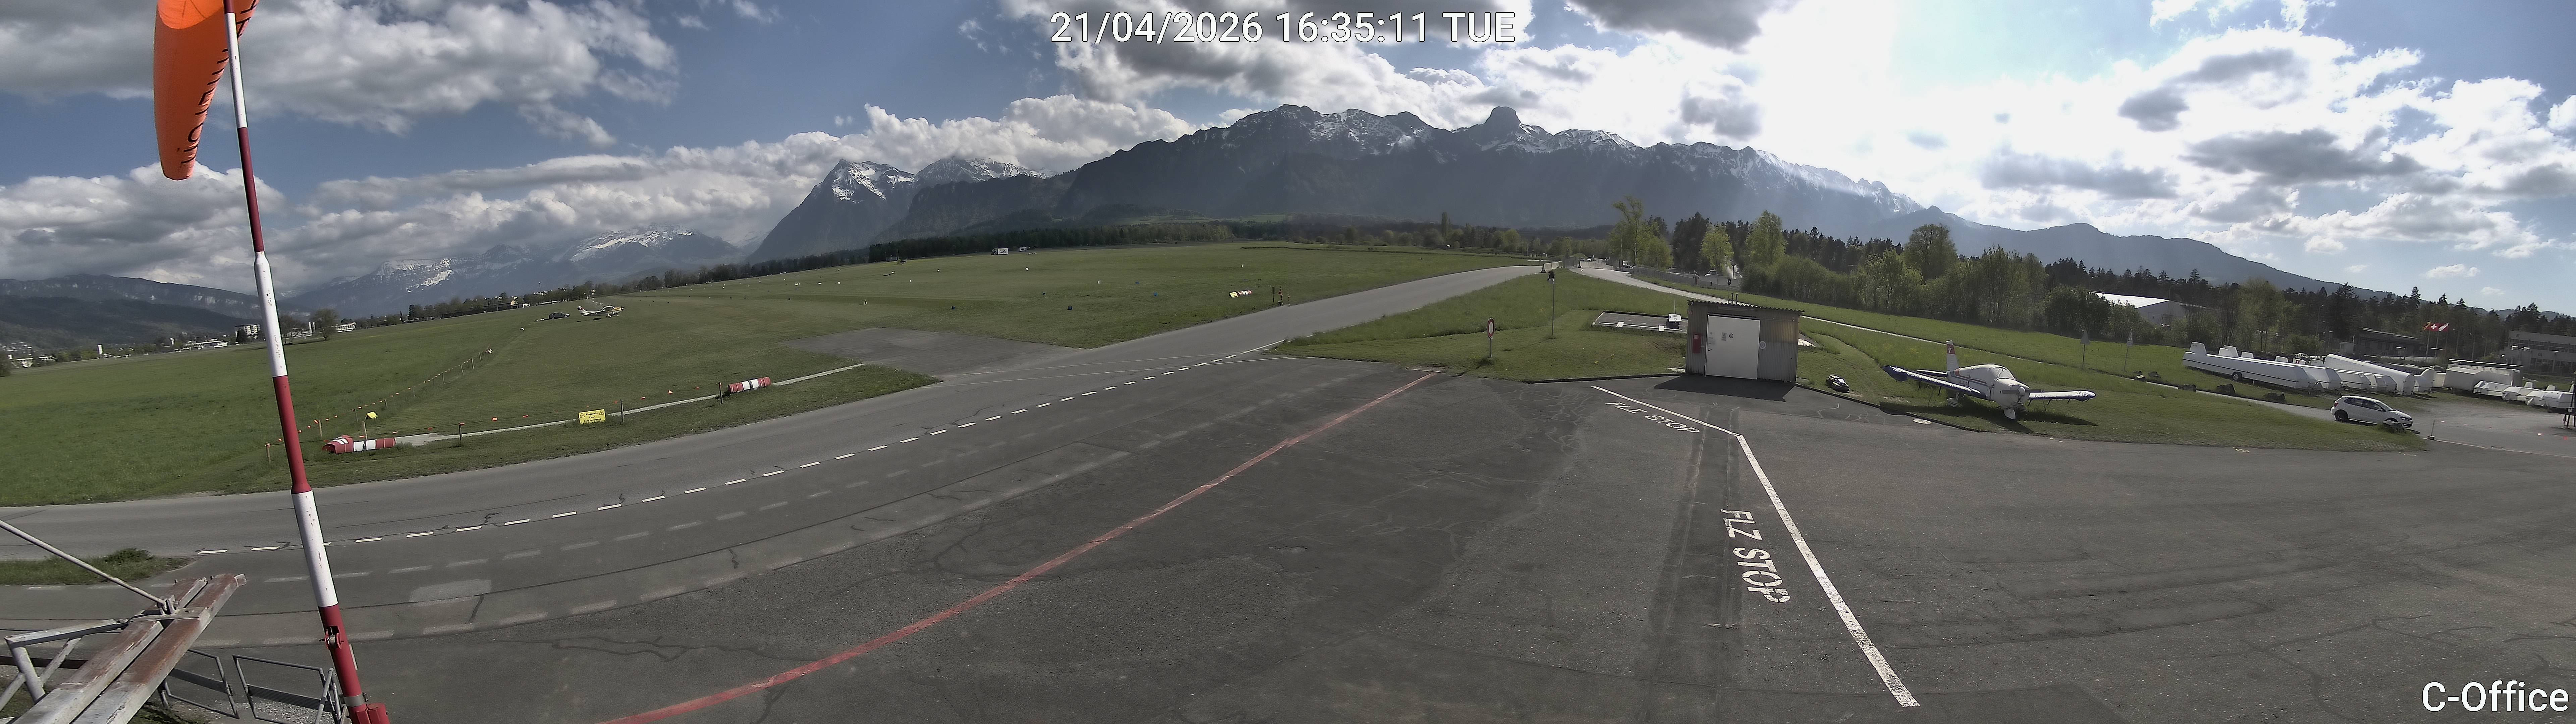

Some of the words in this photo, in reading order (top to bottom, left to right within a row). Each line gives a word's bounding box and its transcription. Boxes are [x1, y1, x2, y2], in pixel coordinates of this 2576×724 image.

[1605, 402, 1647, 413] FLZ
[1645, 415, 1700, 432] STOP
[1720, 509, 1763, 540] FLZ
[1733, 547, 1790, 603] STOP
